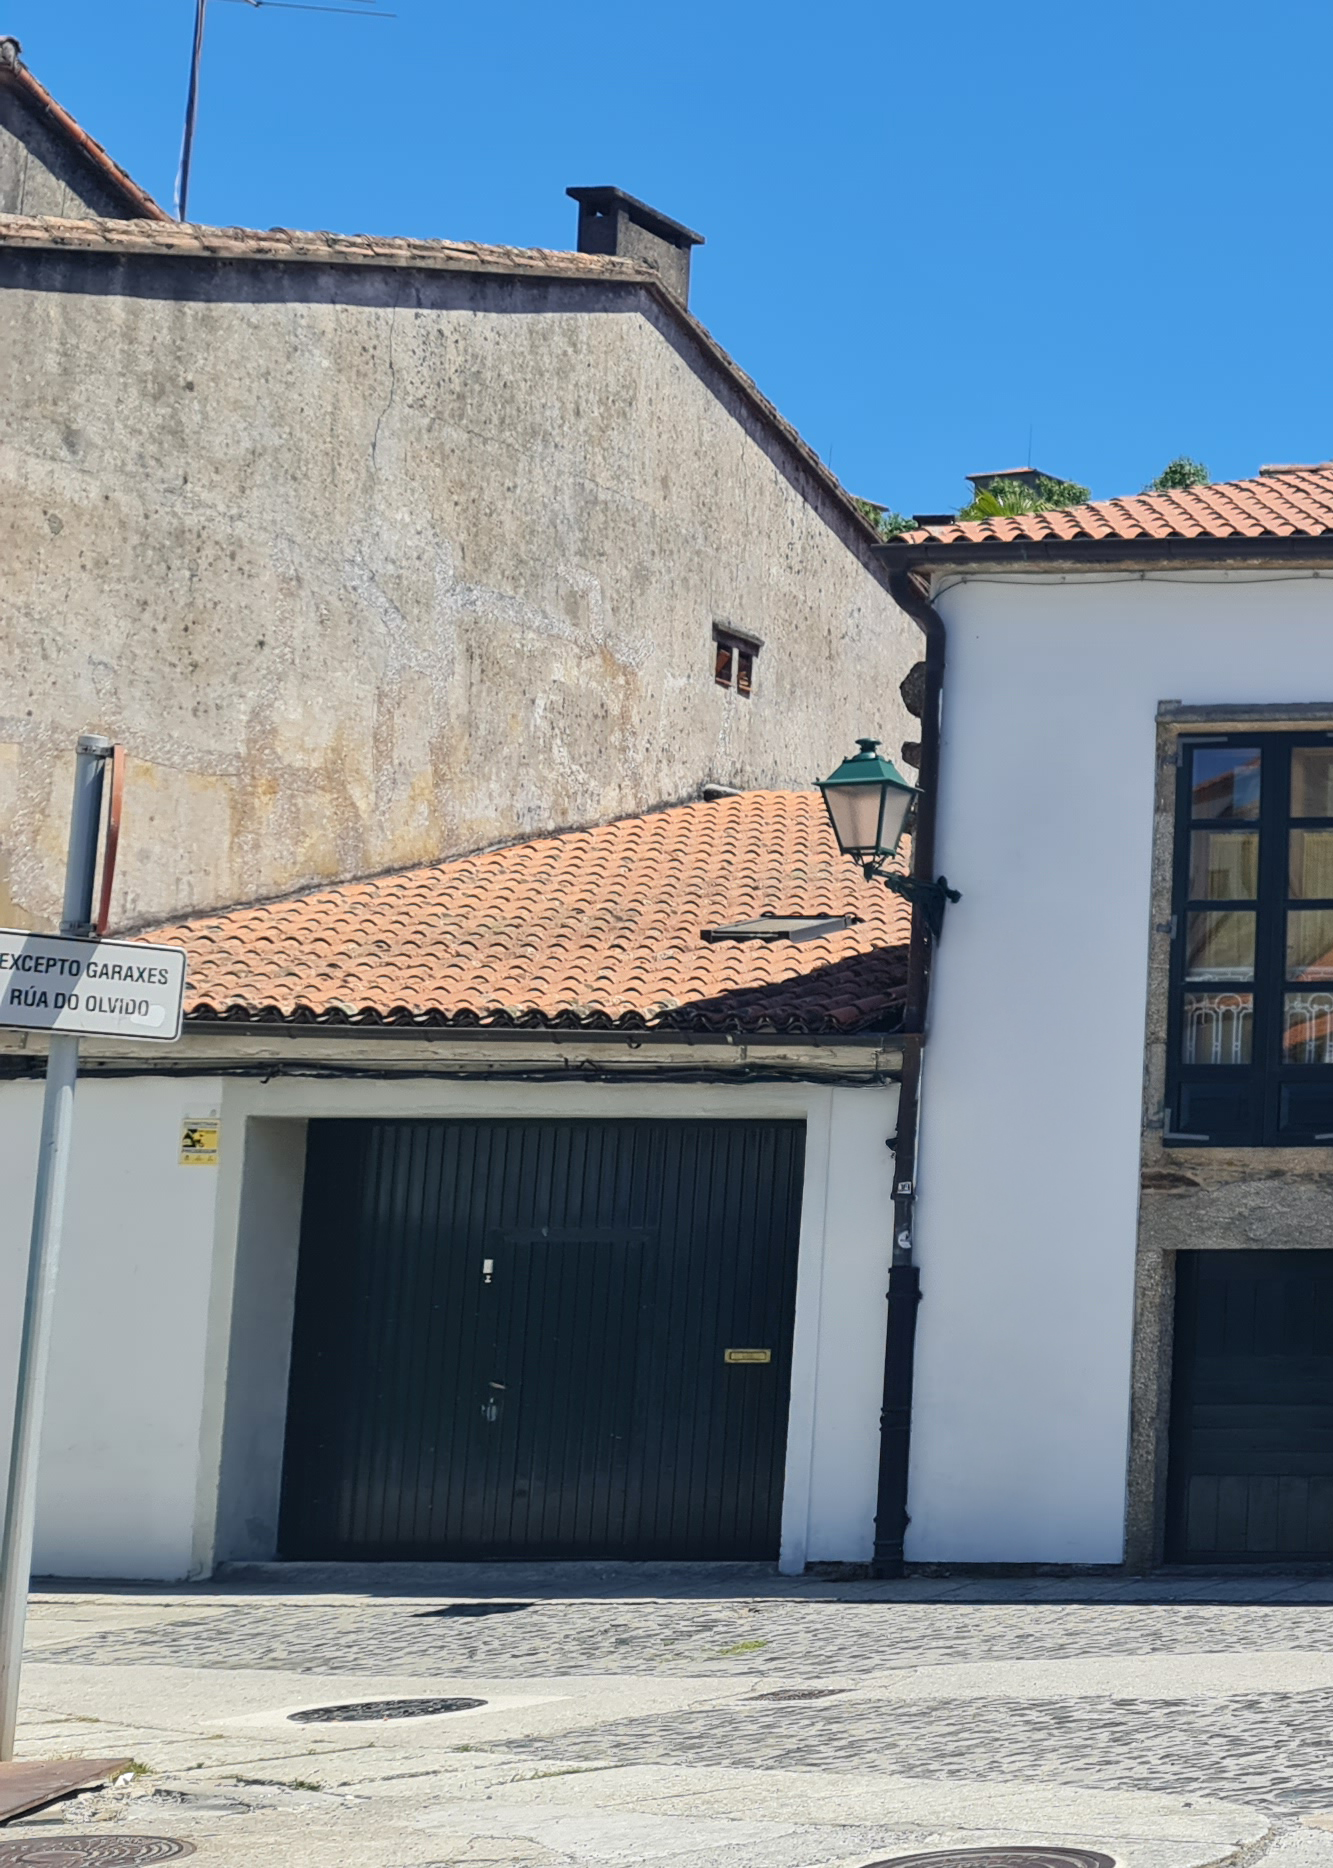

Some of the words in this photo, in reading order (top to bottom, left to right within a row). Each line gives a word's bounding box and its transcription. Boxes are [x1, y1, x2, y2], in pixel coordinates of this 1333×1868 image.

[0, 953, 81, 977] EXCEPTO
[86, 961, 169, 985] GARAXES
[9, 986, 48, 1009] RÚA
[53, 992, 79, 1010] DO
[85, 995, 149, 1017] OLVIDO
